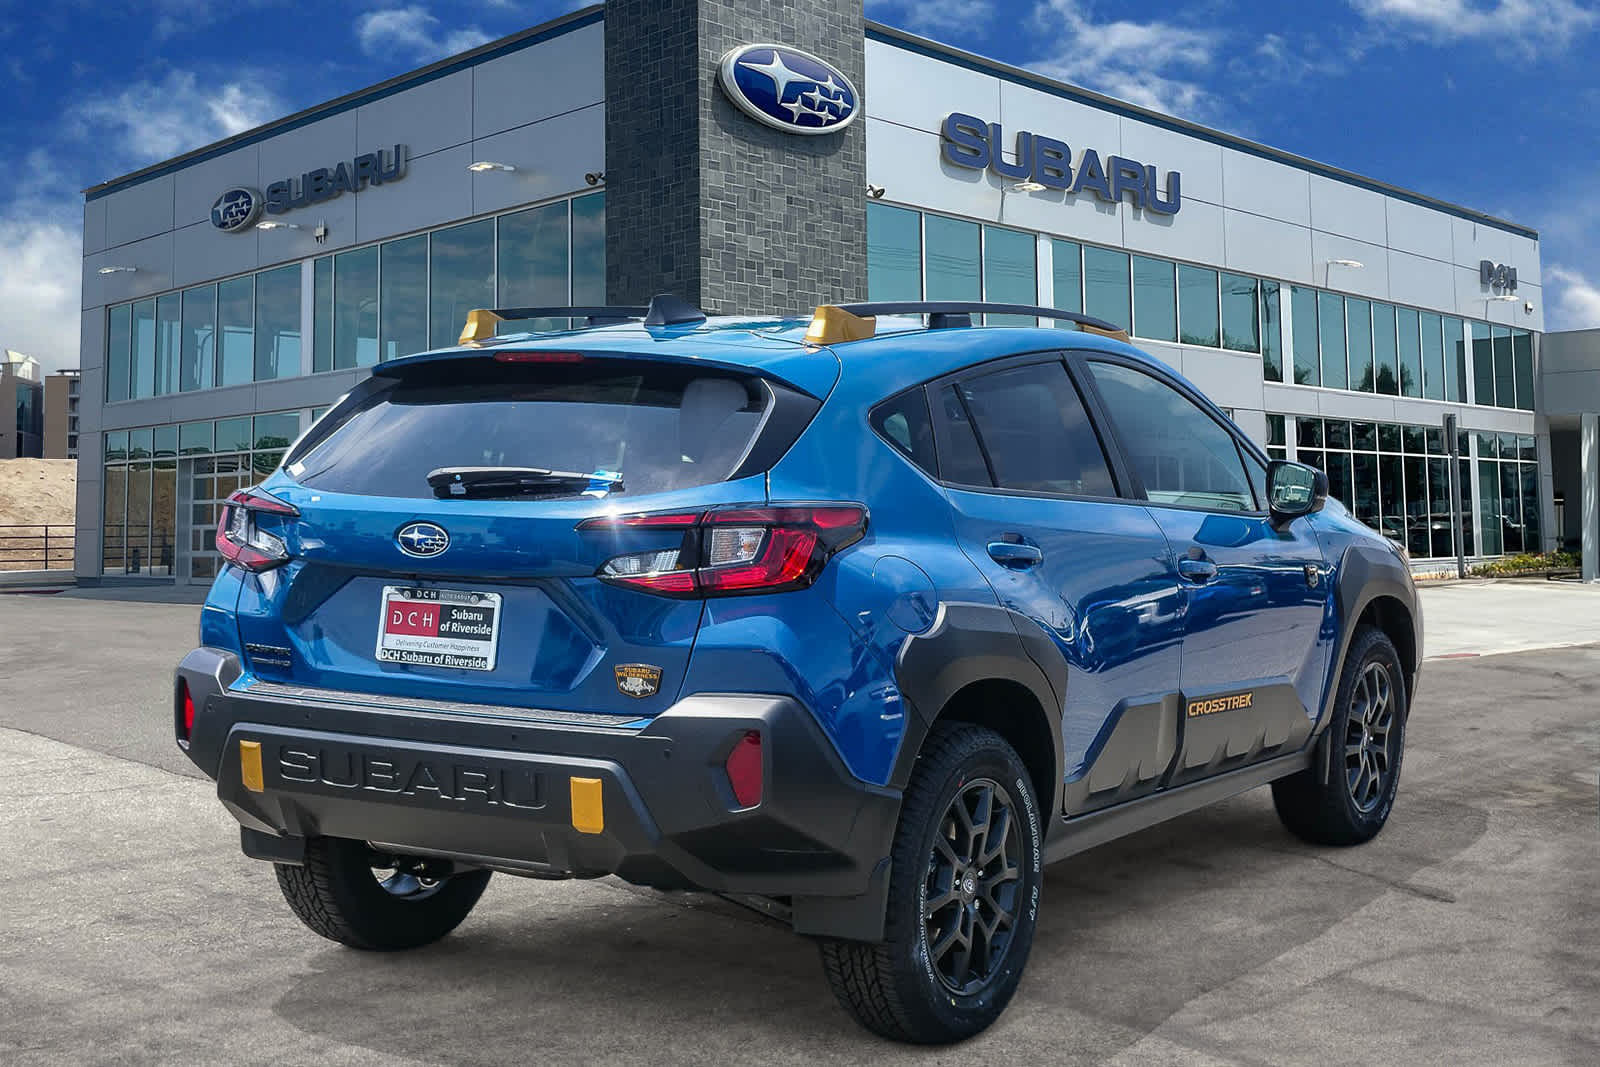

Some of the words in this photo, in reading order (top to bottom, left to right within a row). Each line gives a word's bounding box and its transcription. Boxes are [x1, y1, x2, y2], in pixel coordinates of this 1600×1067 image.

[942, 112, 1181, 215] SUBARU
[266, 144, 407, 215] SUBARU
[416, 590, 437, 599] DCH
[392, 610, 433, 628] DCH
[451, 609, 483, 621] Subaru
[440, 622, 450, 632] of
[451, 622, 492, 635] Riverside
[395, 639, 422, 650] Delivering
[422, 641, 449, 650] Customer
[450, 643, 480, 653] Happiness
[381, 649, 400, 660] DCH
[401, 651, 432, 664] Subaru
[434, 654, 444, 665] of
[445, 656, 487, 669] Riverside
[1188, 693, 1253, 716] CROSSTREK
[279, 745, 547, 809] SUBARU
